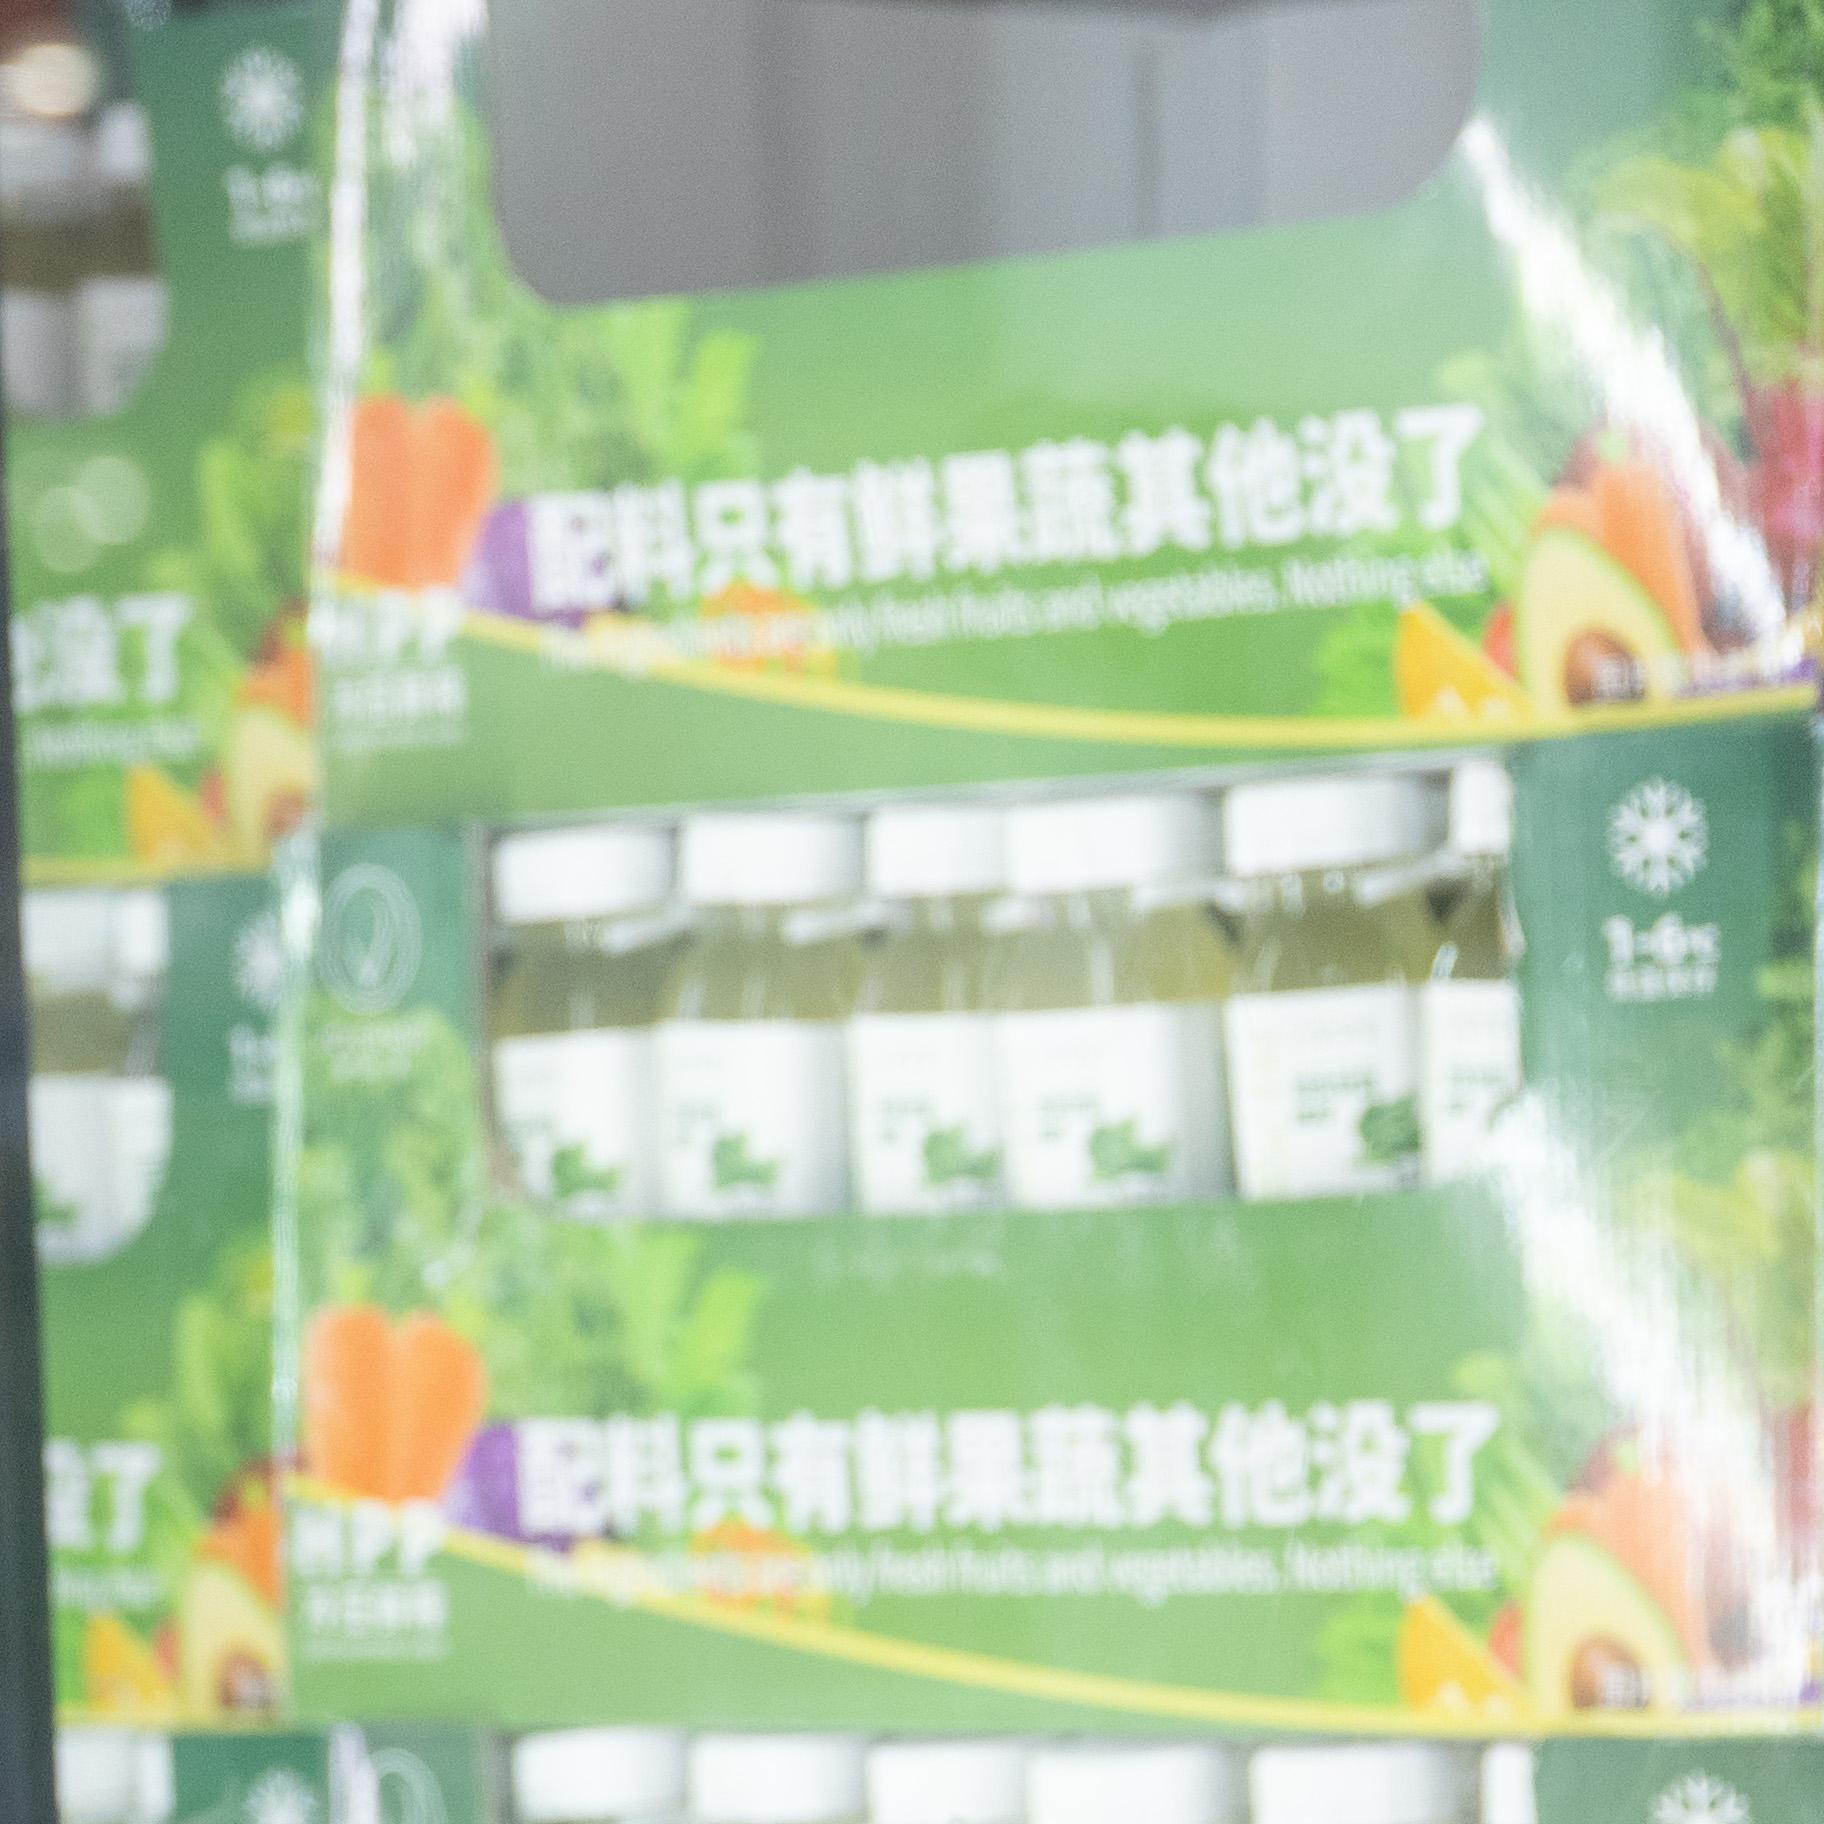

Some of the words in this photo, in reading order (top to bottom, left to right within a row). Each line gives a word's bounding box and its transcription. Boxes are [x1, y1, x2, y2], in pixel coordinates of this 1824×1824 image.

[532, 405, 1482, 612] 配料只有鲜果蔬其他没了
[519, 1402, 1498, 1537] 配料只有鲜果蔬其他没了
